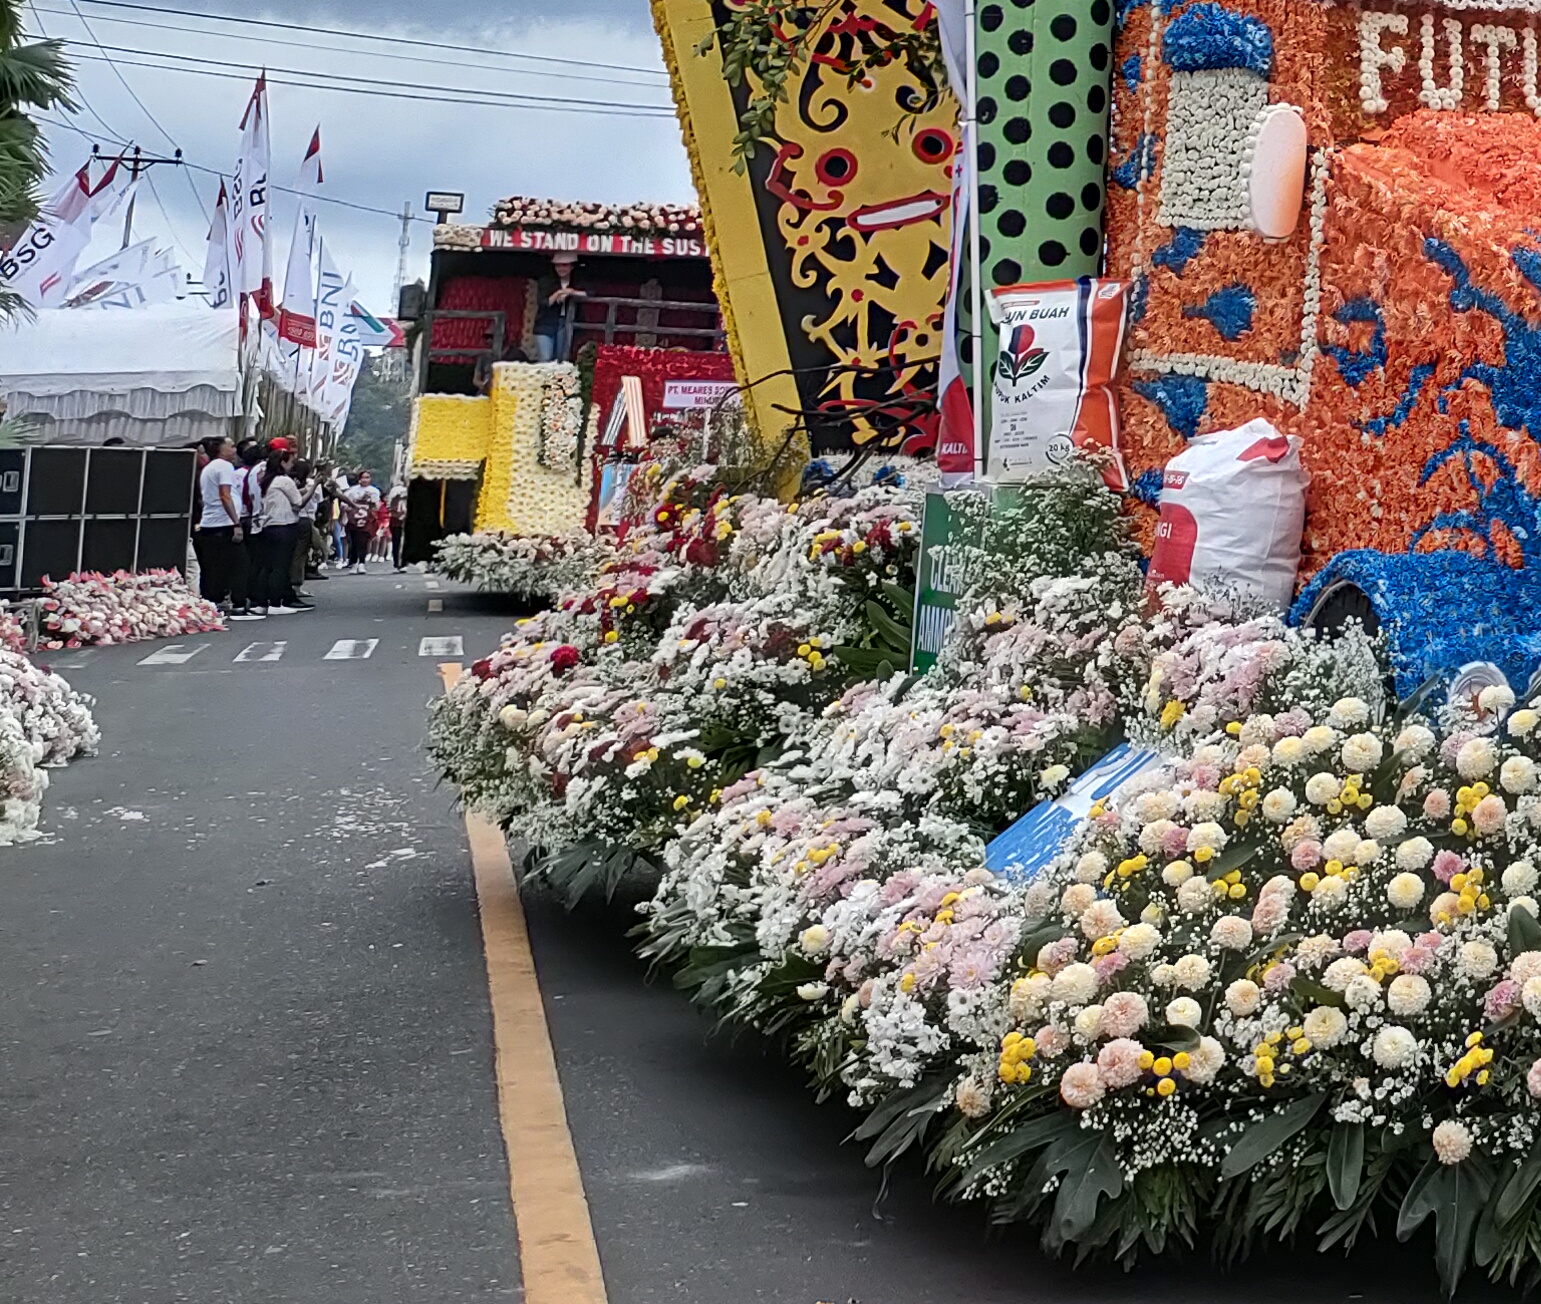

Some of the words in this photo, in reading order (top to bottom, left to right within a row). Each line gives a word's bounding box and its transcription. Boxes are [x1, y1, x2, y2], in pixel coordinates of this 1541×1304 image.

[0, 227, 56, 280] BSG
[489, 229, 512, 247] WE
[520, 230, 579, 251] STAND
[588, 233, 614, 253] ON
[620, 235, 655, 255] THE
[1014, 375, 1050, 404] KALTIM
